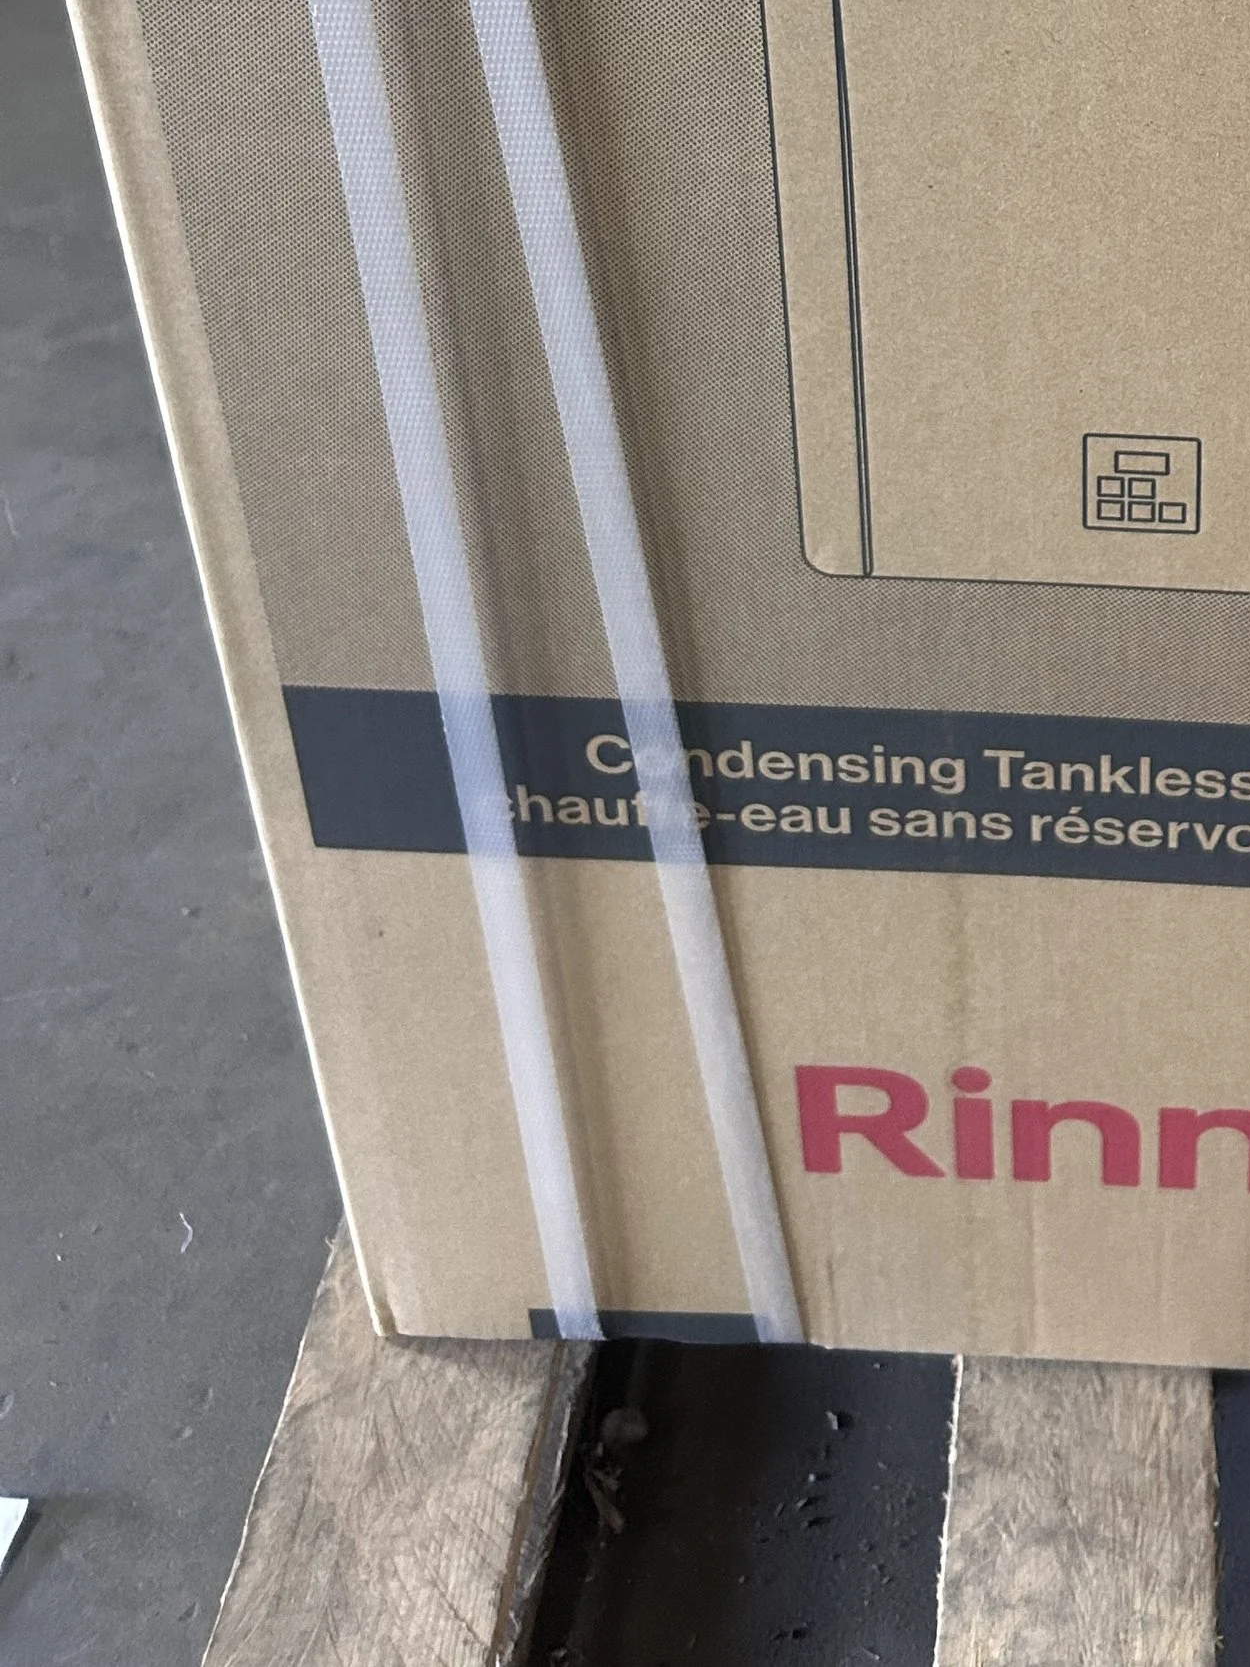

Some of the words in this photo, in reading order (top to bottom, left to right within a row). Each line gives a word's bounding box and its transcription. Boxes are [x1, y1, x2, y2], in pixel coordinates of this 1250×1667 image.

[586, 733, 967, 796] Cndensing
[510, 783, 852, 835] haufe-eau
[869, 805, 1013, 841] sans
